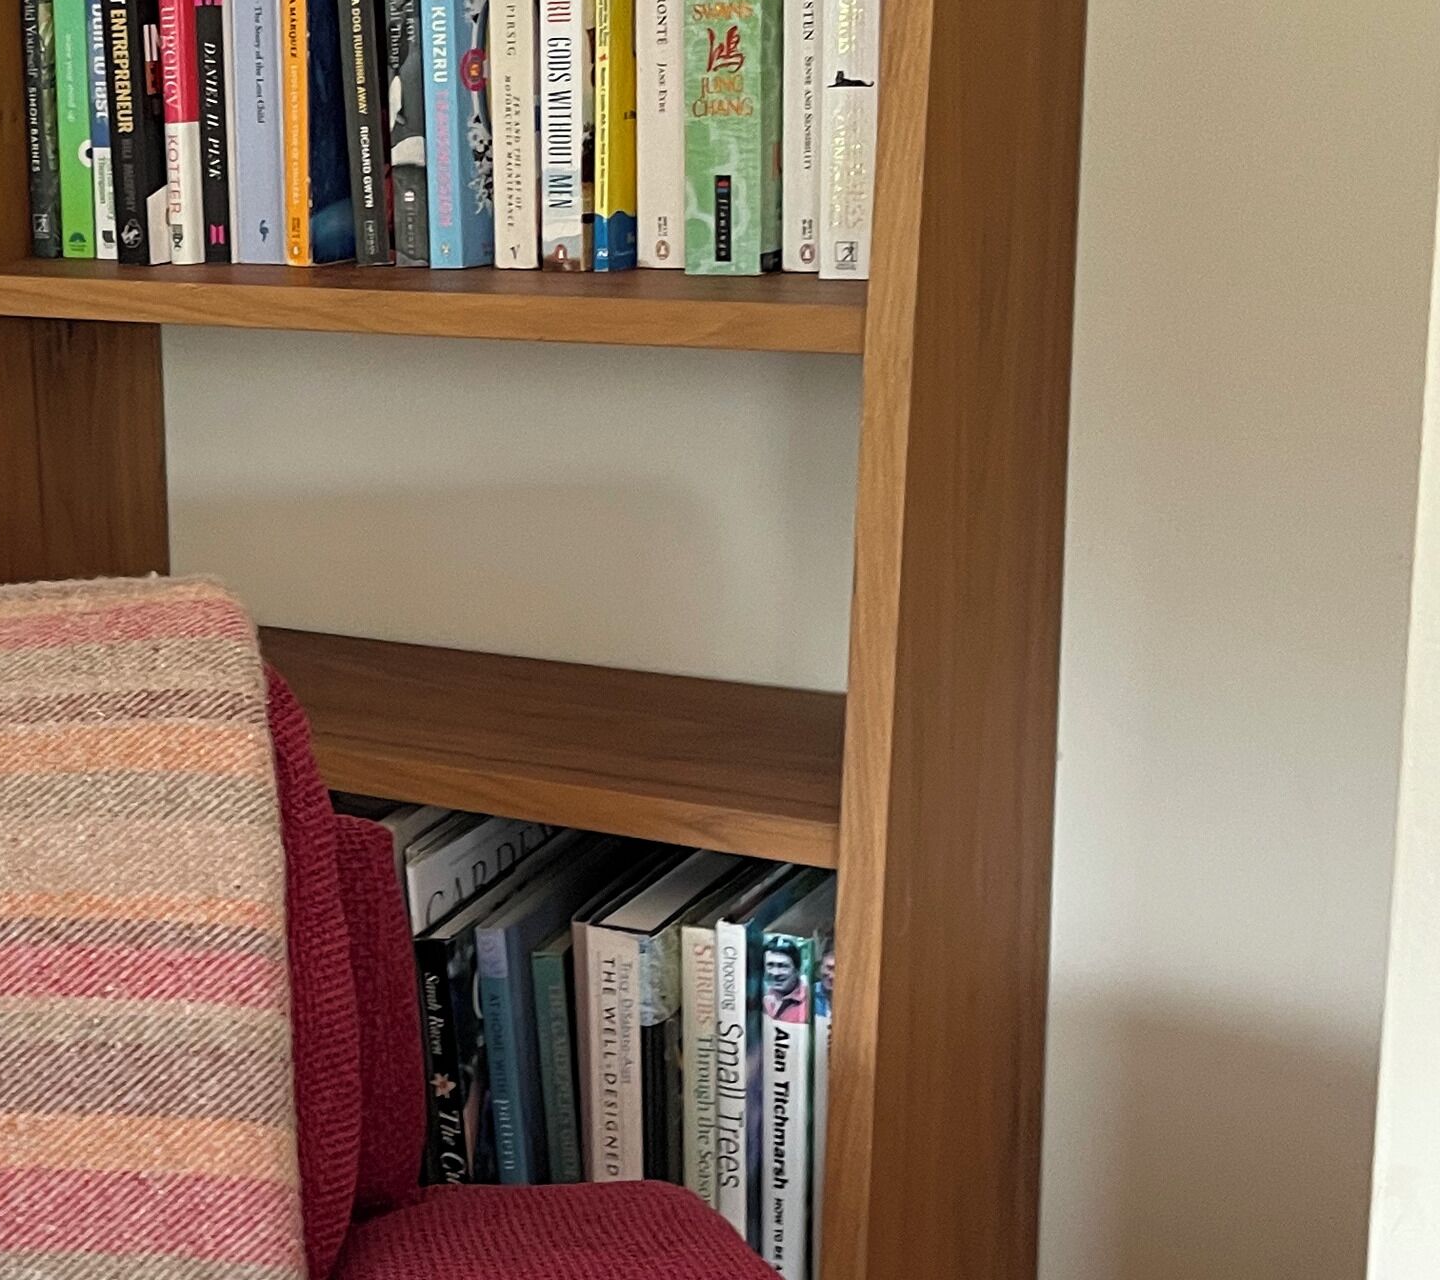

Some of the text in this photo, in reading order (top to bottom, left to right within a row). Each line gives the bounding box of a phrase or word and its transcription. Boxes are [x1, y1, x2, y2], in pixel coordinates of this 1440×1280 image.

[351, 8, 362, 33] DOG
[431, 6, 448, 83] KUNZRU
[505, 5, 518, 57] PIRSIG
[25, 24, 39, 78] Yourself
[110, 8, 134, 134] ENTREPRENEUR
[160, 6, 180, 110] urgency
[352, 35, 366, 85] RUNNING
[388, 23, 401, 72] Things
[547, 37, 572, 83] GODS
[203, 42, 219, 108] DANIEL
[656, 62, 668, 113] JANE EYRE
[27, 86, 38, 126] SIMON
[356, 86, 369, 116] AWAY
[692, 96, 754, 118] CHANG
[803, 89, 814, 111] AND
[31, 128, 41, 173] BARNES
[359, 125, 372, 174] RICHARD
[504, 75, 515, 228] MOTORCYCLE MAINTENANCE
[513, 119, 522, 144] AND
[548, 89, 572, 166] WITHOUT
[802, 112, 814, 170] SENSIBILITY
[167, 134, 182, 214] KOTTER
[208, 137, 222, 179] PINK
[514, 147, 522, 169] THE
[363, 176, 375, 208] GWYN
[548, 174, 573, 209] MEN
[424, 972, 442, 1011] Sarah
[602, 957, 616, 995] THE
[694, 943, 713, 1024] SHRUBS
[428, 1015, 445, 1054] Raven
[489, 993, 516, 1171] AT HOME WITH pattern
[694, 1034, 717, 1112] Through
[717, 946, 746, 1189] Choosing Small Trees
[438, 1109, 462, 1146] The
[697, 1115, 716, 1145] the
[773, 1026, 790, 1260] Alan Titchmarsh HOW TO BE
